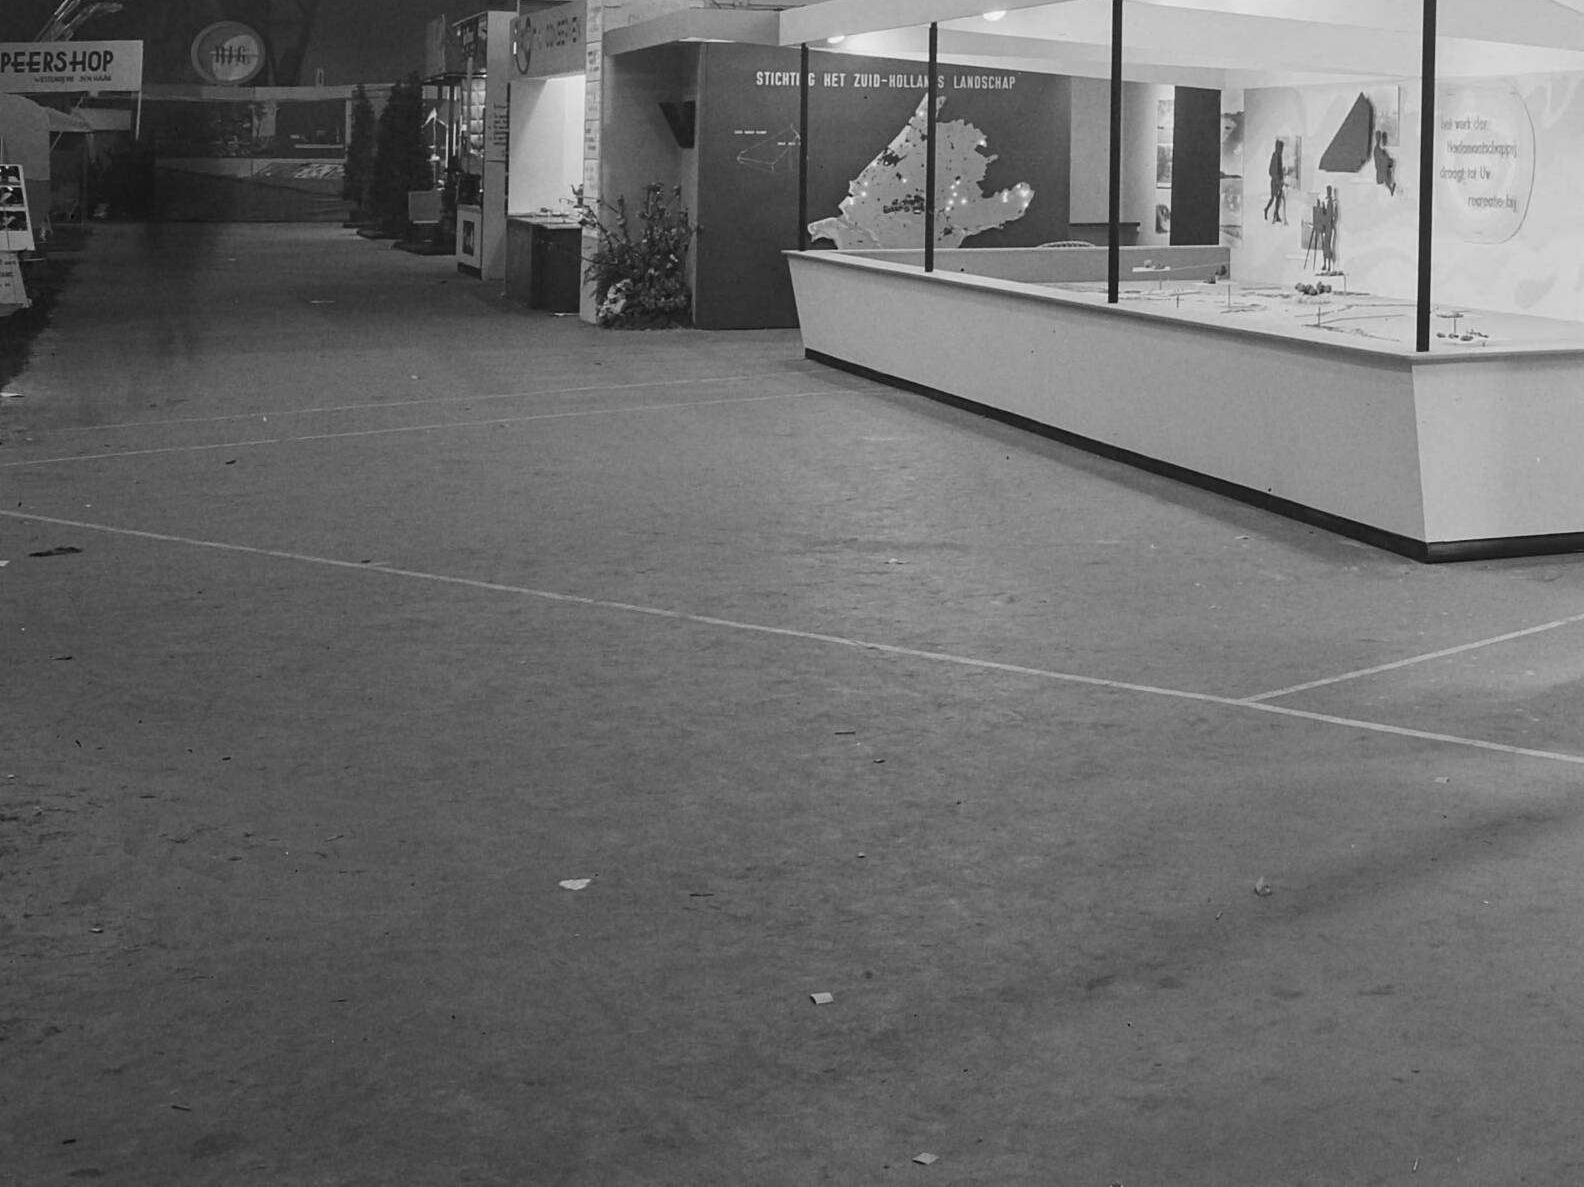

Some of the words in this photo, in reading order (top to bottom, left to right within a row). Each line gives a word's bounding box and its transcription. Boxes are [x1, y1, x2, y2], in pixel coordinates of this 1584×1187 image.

[0, 49, 115, 73] PEERSHOP
[756, 71, 816, 87] STICHTIG
[824, 73, 847, 88] HET
[854, 73, 945, 89] ZUID-HOLLANS
[953, 75, 1016, 90] LANDSCHAP
